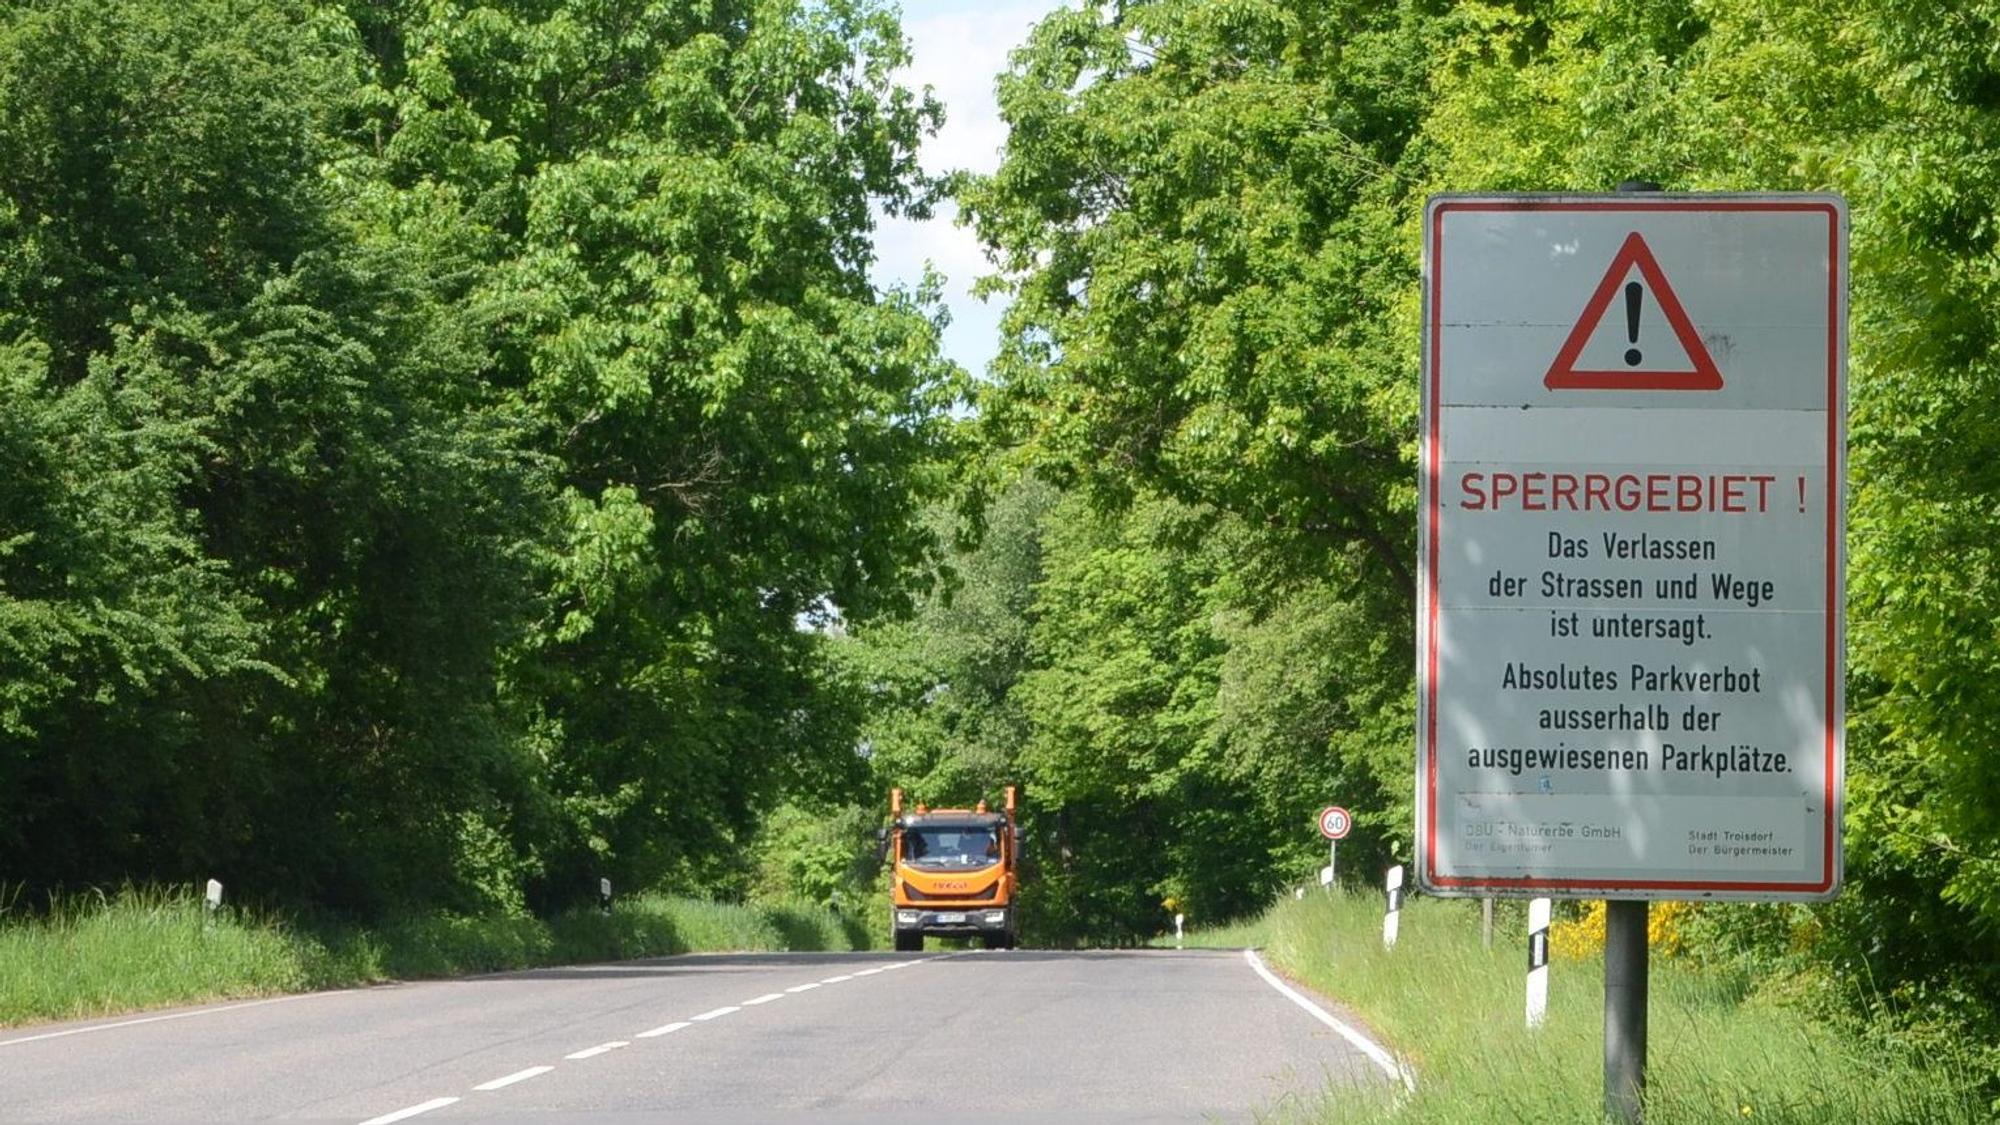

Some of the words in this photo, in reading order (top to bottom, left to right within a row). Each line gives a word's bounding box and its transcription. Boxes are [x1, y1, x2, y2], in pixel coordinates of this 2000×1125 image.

[1460, 473, 1776, 513] SPERRGEBIET
[1548, 531, 1589, 559] Das
[1602, 532, 1716, 560] Verlassen
[1489, 571, 1527, 597] der
[1541, 571, 1643, 599] Strassen
[1656, 574, 1697, 600] und
[1711, 574, 1774, 606] Wege
[1551, 611, 1579, 637] ist
[1592, 614, 1713, 646] untersagt.
[1502, 663, 1618, 690] Absolutes
[1631, 664, 1761, 693] Parkverbot
[1539, 705, 1669, 731] ausserhalb
[1682, 706, 1722, 732] der
[1468, 743, 1649, 775] ausgewiesenen
[1662, 744, 1793, 778] Parkplätze.
[1327, 816, 1343, 830] 60
[1508, 824, 1574, 837] Naturerbe
[1581, 825, 1621, 839] GmbH
[1688, 830, 1718, 841] Stadt
[1724, 831, 1773, 842] Troisdorf
[1688, 844, 1708, 855] Der
